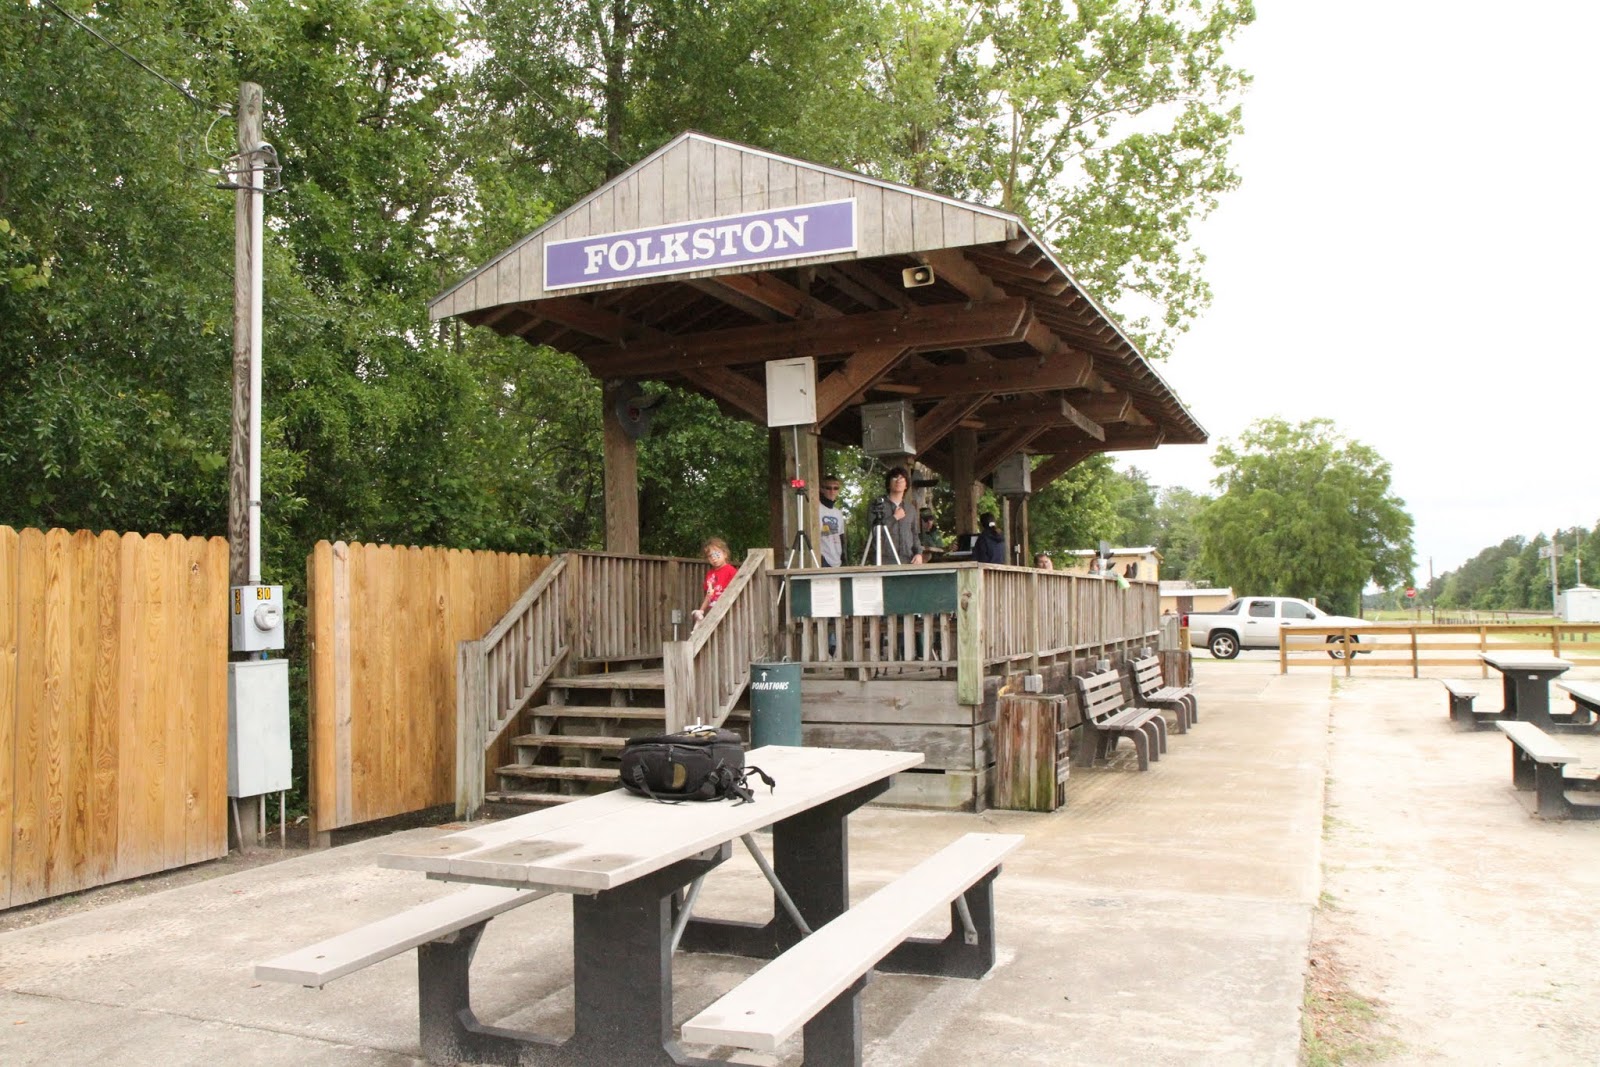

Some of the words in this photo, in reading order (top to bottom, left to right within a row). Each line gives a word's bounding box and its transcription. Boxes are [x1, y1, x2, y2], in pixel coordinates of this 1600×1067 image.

[584, 215, 809, 275] FOLKSTON
[257, 587, 271, 600] 30
[751, 681, 790, 690] DONATIONS
